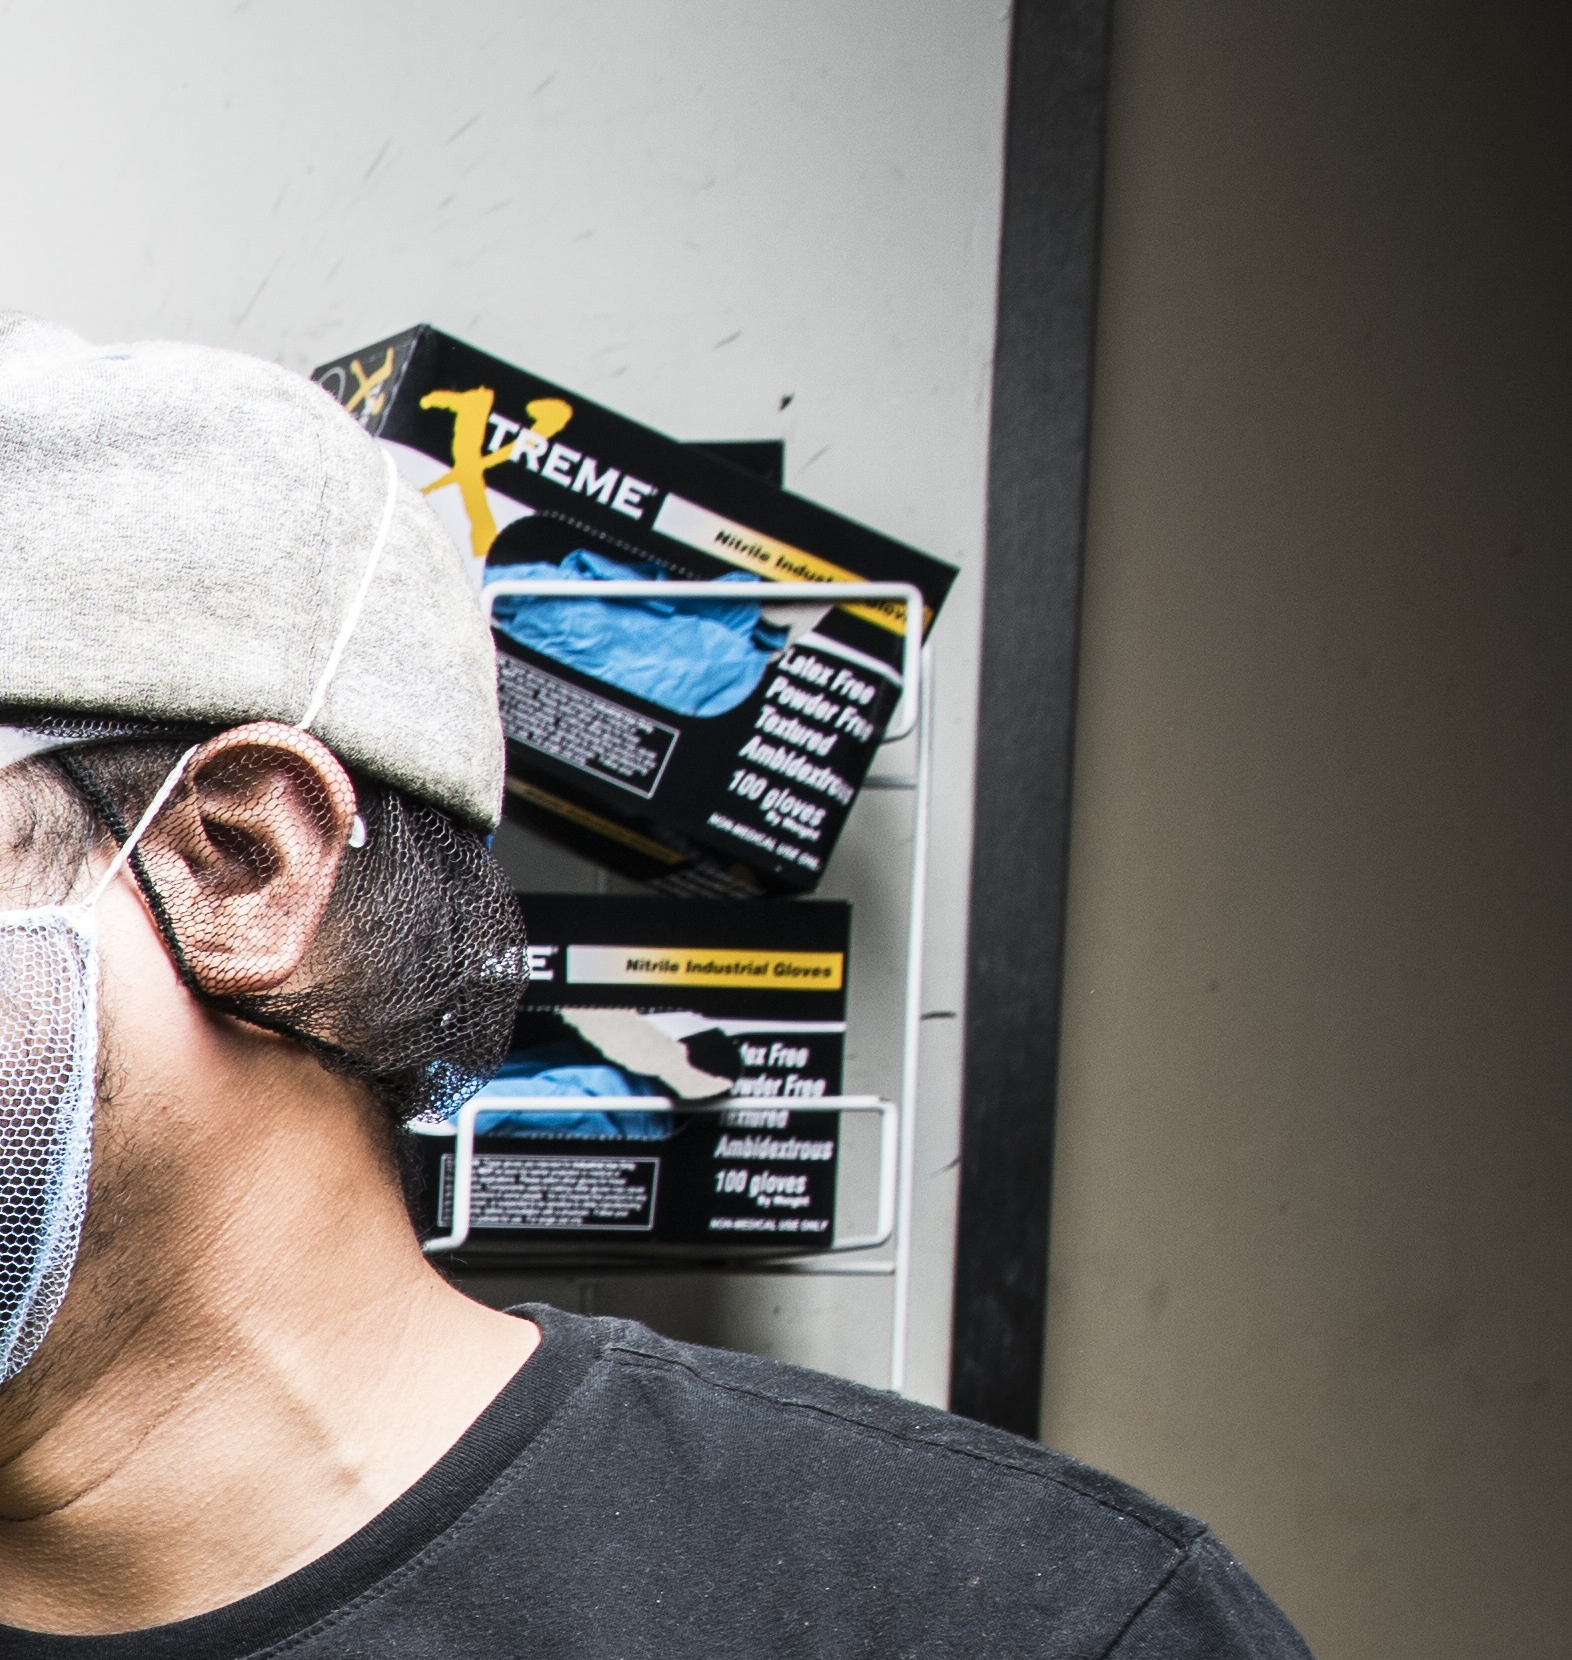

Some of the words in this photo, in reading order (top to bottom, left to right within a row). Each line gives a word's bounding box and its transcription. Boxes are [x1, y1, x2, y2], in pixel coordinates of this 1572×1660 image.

[714, 530, 770, 563] Nitrile
[777, 647, 835, 687] Latex
[830, 667, 875, 706] Free
[765, 675, 840, 723] Powder
[754, 704, 838, 756] Textured
[728, 769, 768, 800] 100
[760, 788, 826, 828] gloves
[625, 958, 679, 973] Nitrile
[686, 959, 767, 976] Industrial
[774, 961, 832, 978] Gloves
[768, 1042, 810, 1067] Free
[783, 1073, 828, 1098] Free
[713, 1134, 834, 1160] Ambidextrous
[715, 1169, 748, 1192] 100
[748, 1171, 808, 1198] gloves
